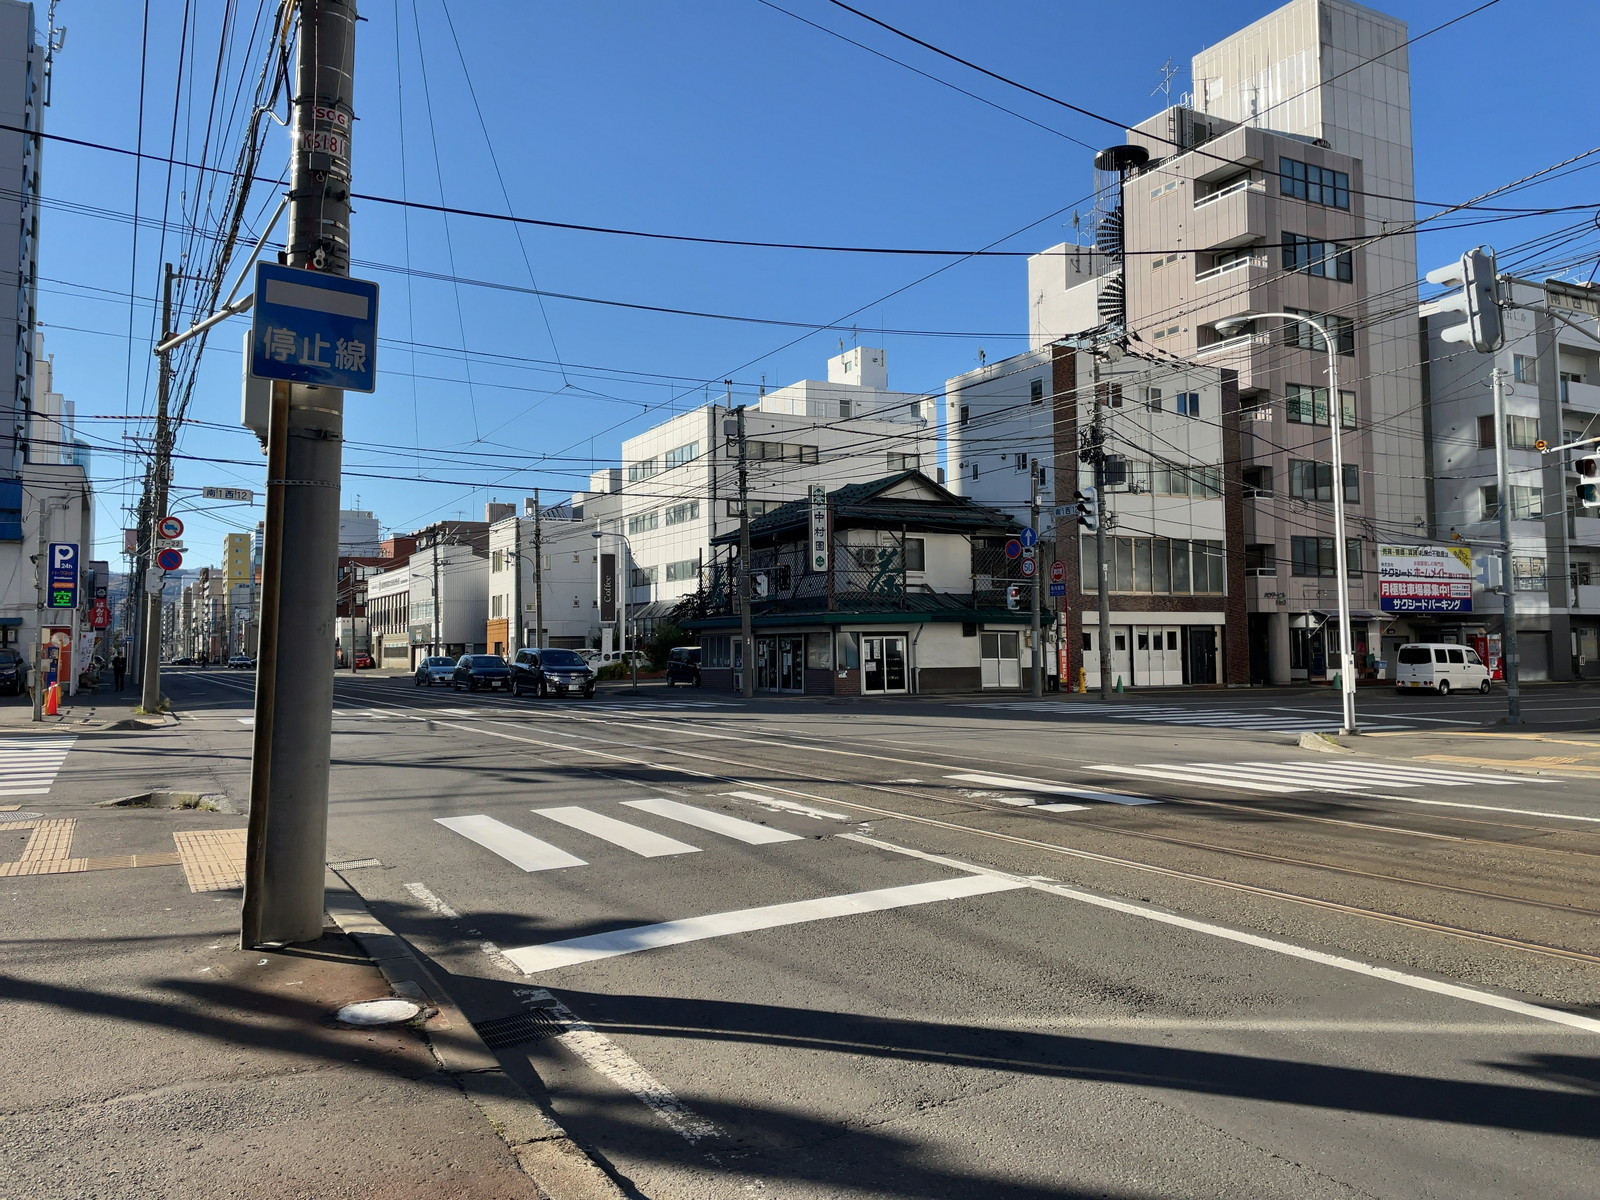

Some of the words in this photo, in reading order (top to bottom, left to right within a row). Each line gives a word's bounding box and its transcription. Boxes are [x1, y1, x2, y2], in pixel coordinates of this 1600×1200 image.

[263, 325, 366, 372] 停止線
[206, 489, 248, 500] 南1西12
[814, 511, 825, 552] 中村園
[1024, 563, 1033, 572] 50
[603, 575, 612, 603] Coffee
